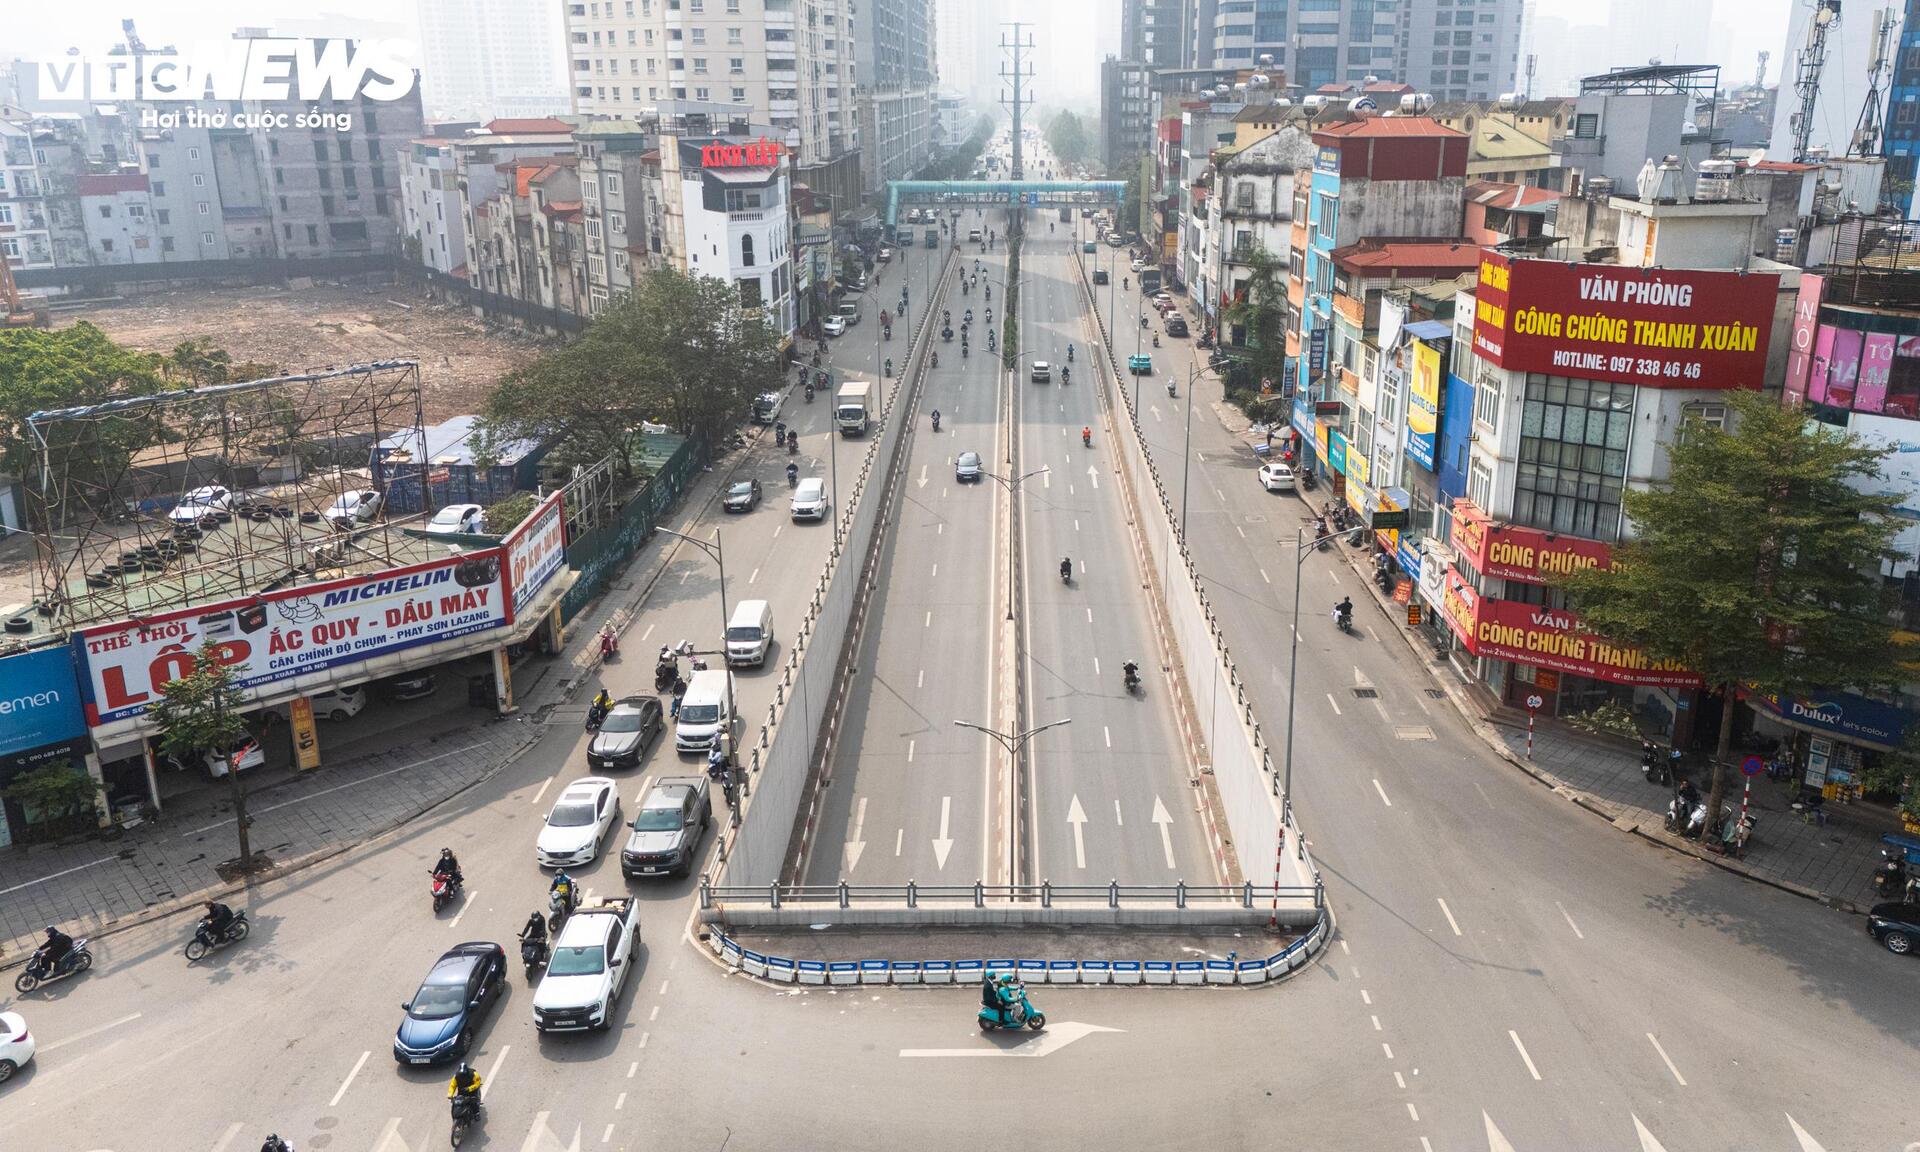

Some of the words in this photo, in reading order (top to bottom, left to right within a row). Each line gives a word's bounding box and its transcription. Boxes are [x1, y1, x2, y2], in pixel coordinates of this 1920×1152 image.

[702, 140, 742, 167] KÍNH
[1580, 274, 1618, 302] VĂN
[1623, 277, 1693, 308] PHÒNG
[1514, 305, 1562, 338] CÔNG
[1566, 312, 1628, 345] CHỨNG
[1633, 319, 1696, 350] THANH
[1699, 320, 1758, 352] XUÂN
[1553, 350, 1607, 372] HOTLINE:
[1610, 356, 1634, 374] 097
[1636, 358, 1661, 377] 338
[1663, 360, 1681, 378] 46
[1683, 361, 1701, 380] 46
[1489, 539, 1534, 569] CÔNG
[323, 568, 452, 608] MICHELIN
[136, 621, 189, 643] THỜI
[269, 627, 303, 656] ẮC
[312, 617, 360, 645] QUY
[385, 598, 433, 628] DẦU
[441, 587, 490, 616] MÁY
[1531, 612, 1569, 630] VĂN
[269, 656, 295, 669] CÂN
[337, 642, 352, 656] ĐỘ
[355, 635, 387, 651] CHỤM
[397, 625, 424, 640] PHAY
[427, 618, 450, 632] SƠN
[451, 610, 490, 627] LAZANG
[1478, 620, 1525, 650] CÔNG
[1526, 629, 1586, 661] CHỨNG
[1589, 641, 1648, 671] THANH
[1494, 648, 1500, 656] 2
[101, 633, 253, 710] LỐP
[275, 668, 296, 679] XUÂN
[302, 665, 313, 673] HÀ
[314, 662, 328, 671] NỘI
[1792, 703, 1834, 725] Dulux
[1861, 725, 1889, 737] colour
